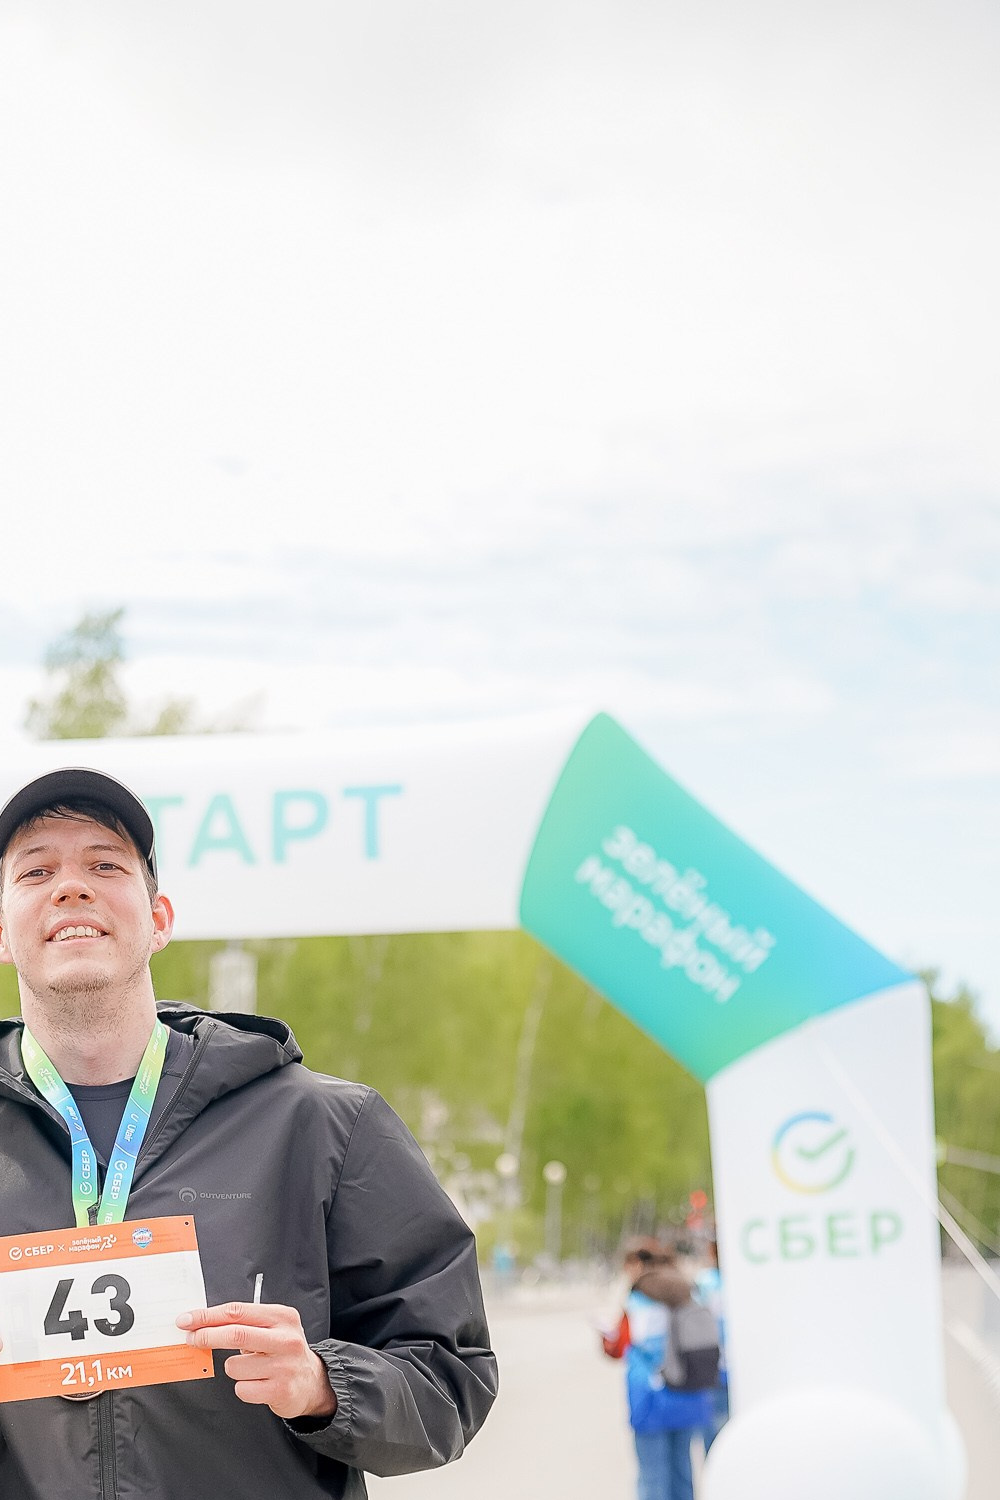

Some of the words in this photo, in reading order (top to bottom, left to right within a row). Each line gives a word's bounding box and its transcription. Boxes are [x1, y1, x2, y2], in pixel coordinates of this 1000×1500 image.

[142, 784, 403, 869] ТАРТ
[576, 856, 740, 1003] марафон
[82, 1150, 90, 1179] СБЕР
[111, 1173, 123, 1199] СБЕР
[200, 1192, 252, 1200] OUTVENTURE
[24, 1244, 54, 1257] СБЕР
[68, 1243, 100, 1253] марафон
[71, 1235, 102, 1246] зелёный
[740, 1209, 904, 1266] СБЕР
[44, 1274, 134, 1340] 43
[60, 1360, 102, 1387] 21,1
